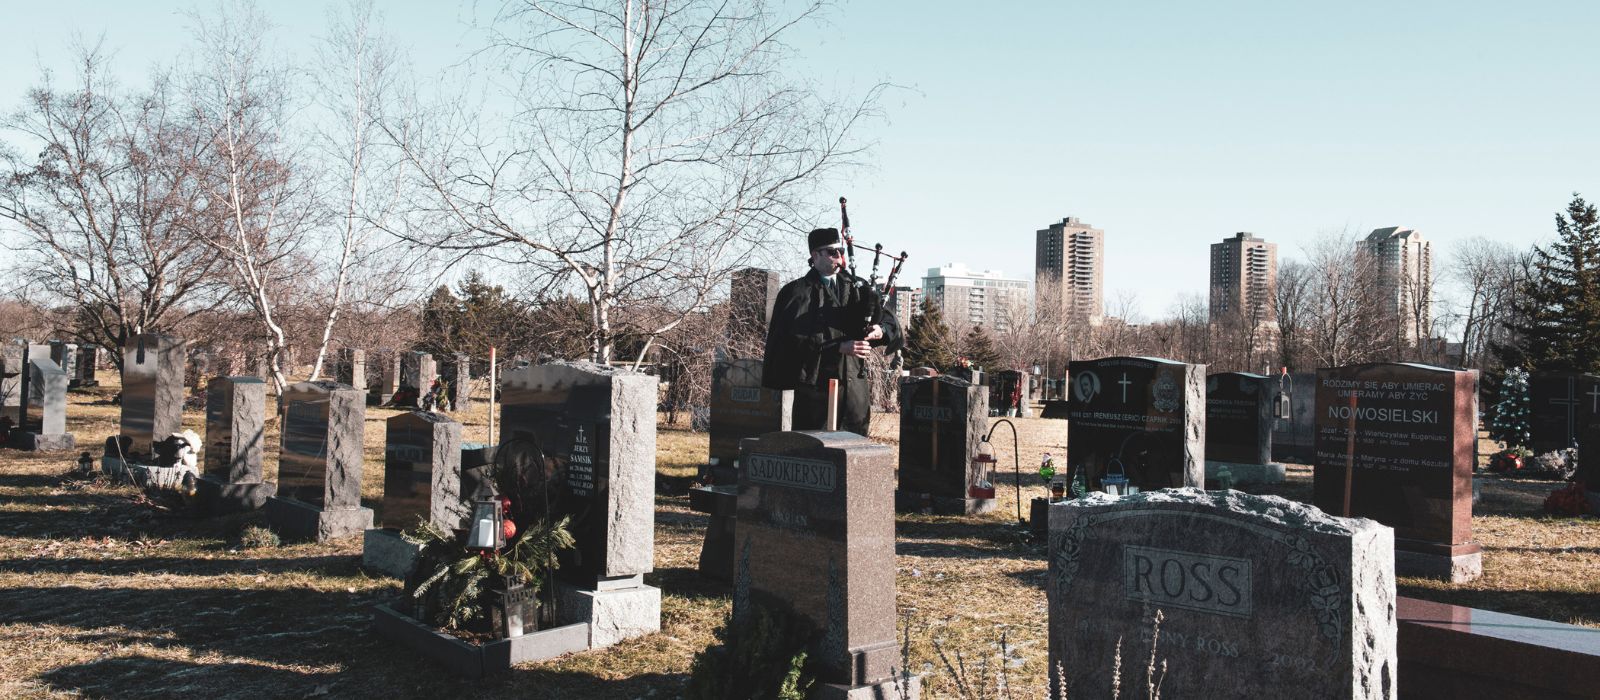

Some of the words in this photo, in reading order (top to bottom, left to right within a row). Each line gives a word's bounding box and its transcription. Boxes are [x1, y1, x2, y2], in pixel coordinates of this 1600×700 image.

[1322, 379, 1361, 388] RODZIMY
[1381, 381, 1400, 390] ABY
[1337, 390, 1385, 399] UMIERAMY
[1388, 391, 1407, 400] ABY
[1093, 411, 1121, 421] IRENEUSZ
[1328, 406, 1438, 424] NOWOSIELSKI
[751, 458, 831, 487] SADOKIERSKI
[1134, 555, 1241, 606] ROSS
[1197, 634, 1239, 657] ROSS
